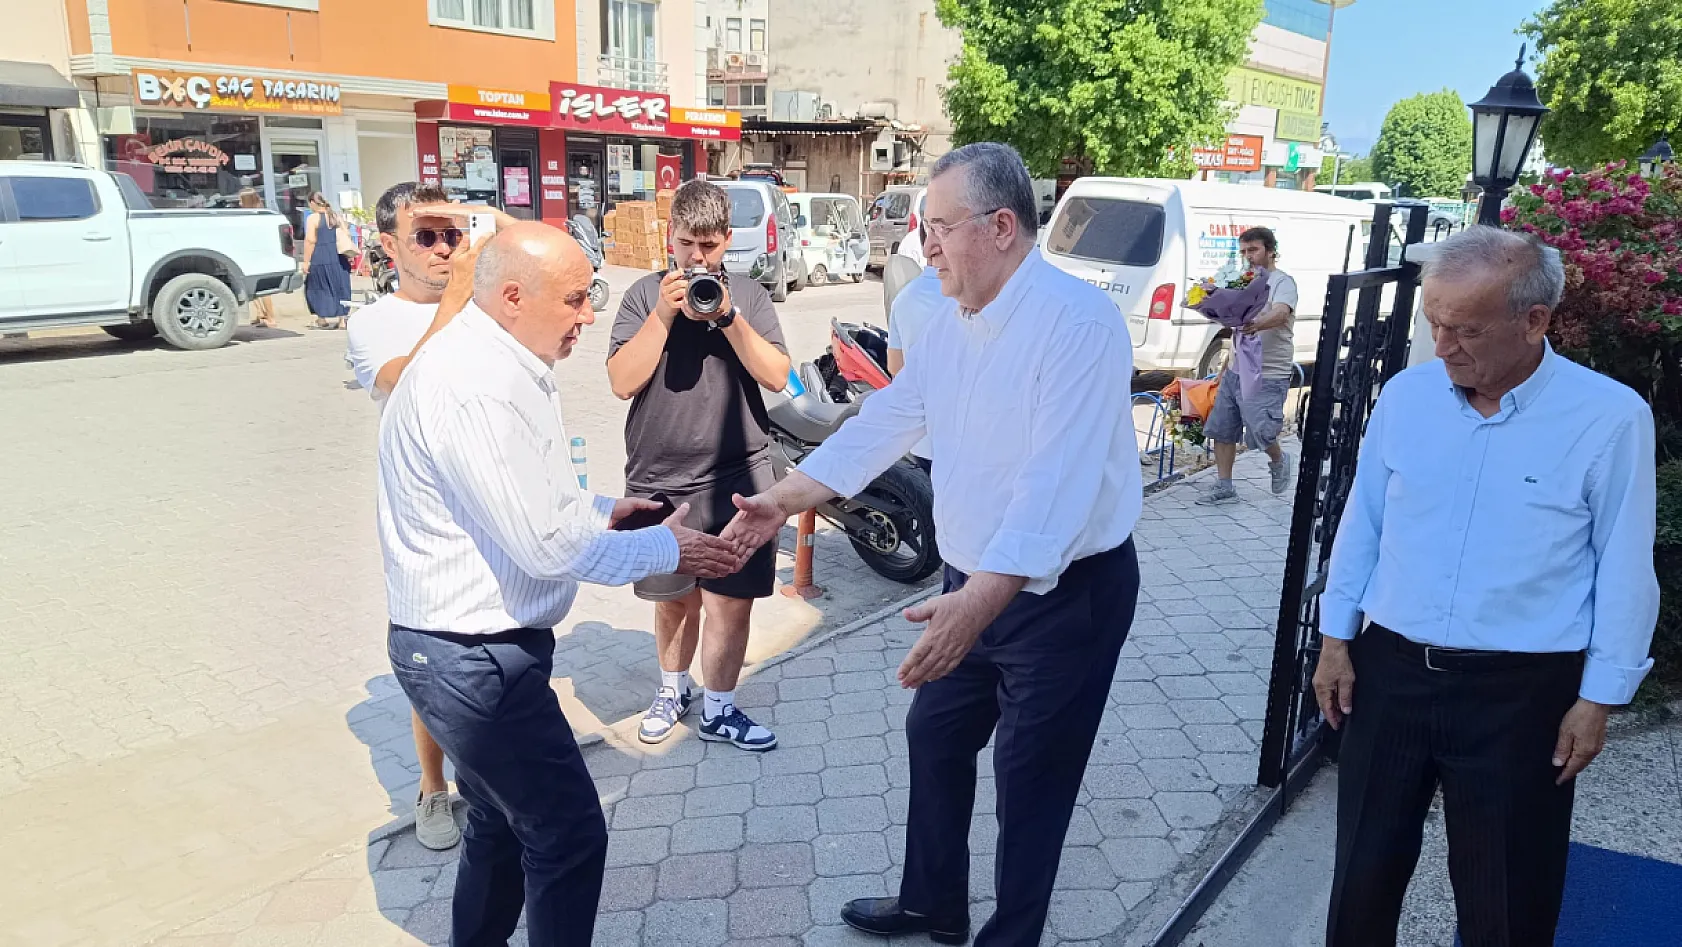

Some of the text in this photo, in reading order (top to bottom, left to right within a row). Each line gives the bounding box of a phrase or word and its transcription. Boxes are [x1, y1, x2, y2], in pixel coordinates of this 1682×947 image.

[216, 76, 254, 97] SAÇ
[262, 79, 341, 102] TASARIM
[477, 90, 524, 105] TOPTAN
[1251, 78, 1316, 110] ENGLISH TIME
[1209, 224, 1227, 236] CAN
